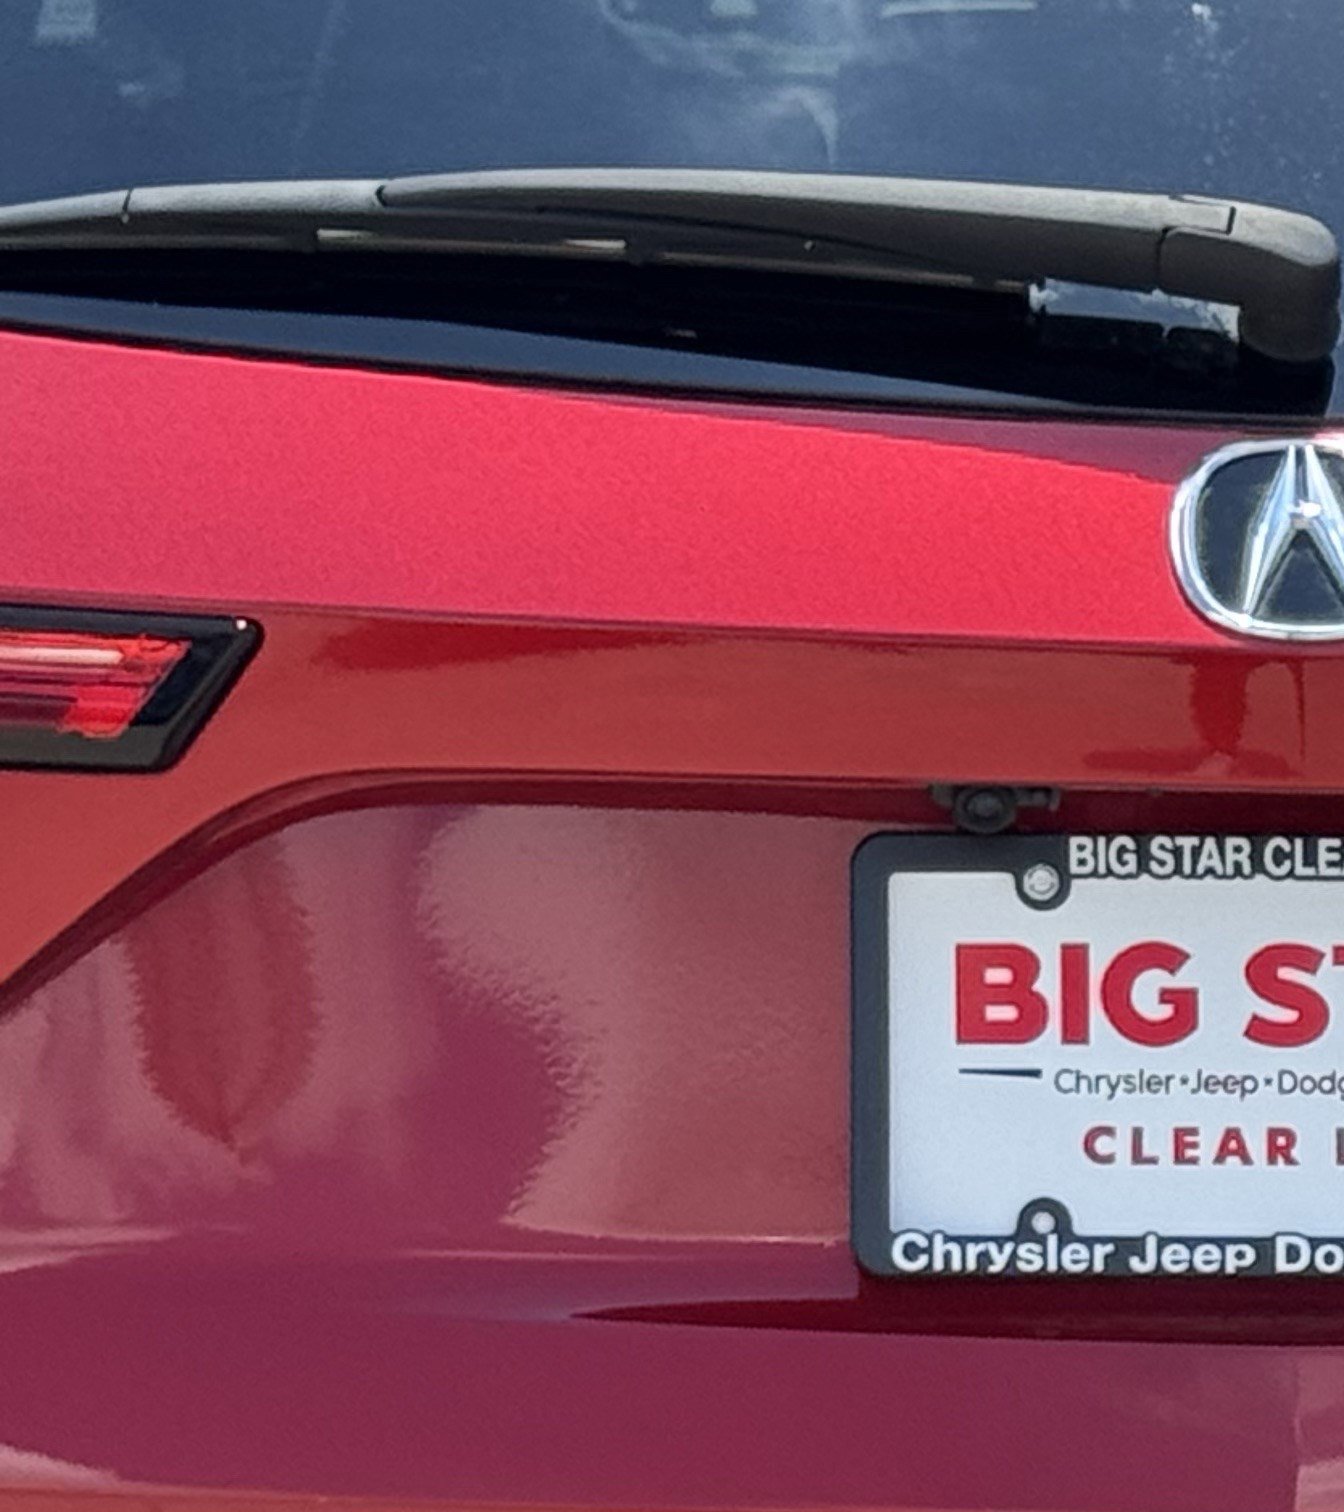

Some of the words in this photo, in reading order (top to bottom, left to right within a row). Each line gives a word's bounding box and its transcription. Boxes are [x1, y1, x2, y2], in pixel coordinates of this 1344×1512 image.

[1068, 835, 1138, 876] BIG
[1148, 836, 1253, 877] STAR
[954, 941, 1200, 1049] BIG
[1053, 1067, 1175, 1101] Chrysler
[1190, 1069, 1260, 1101] Jeep
[1082, 1125, 1300, 1167] CLEAR
[891, 1232, 1115, 1274] Chrysler
[1128, 1232, 1257, 1275] Jeep
